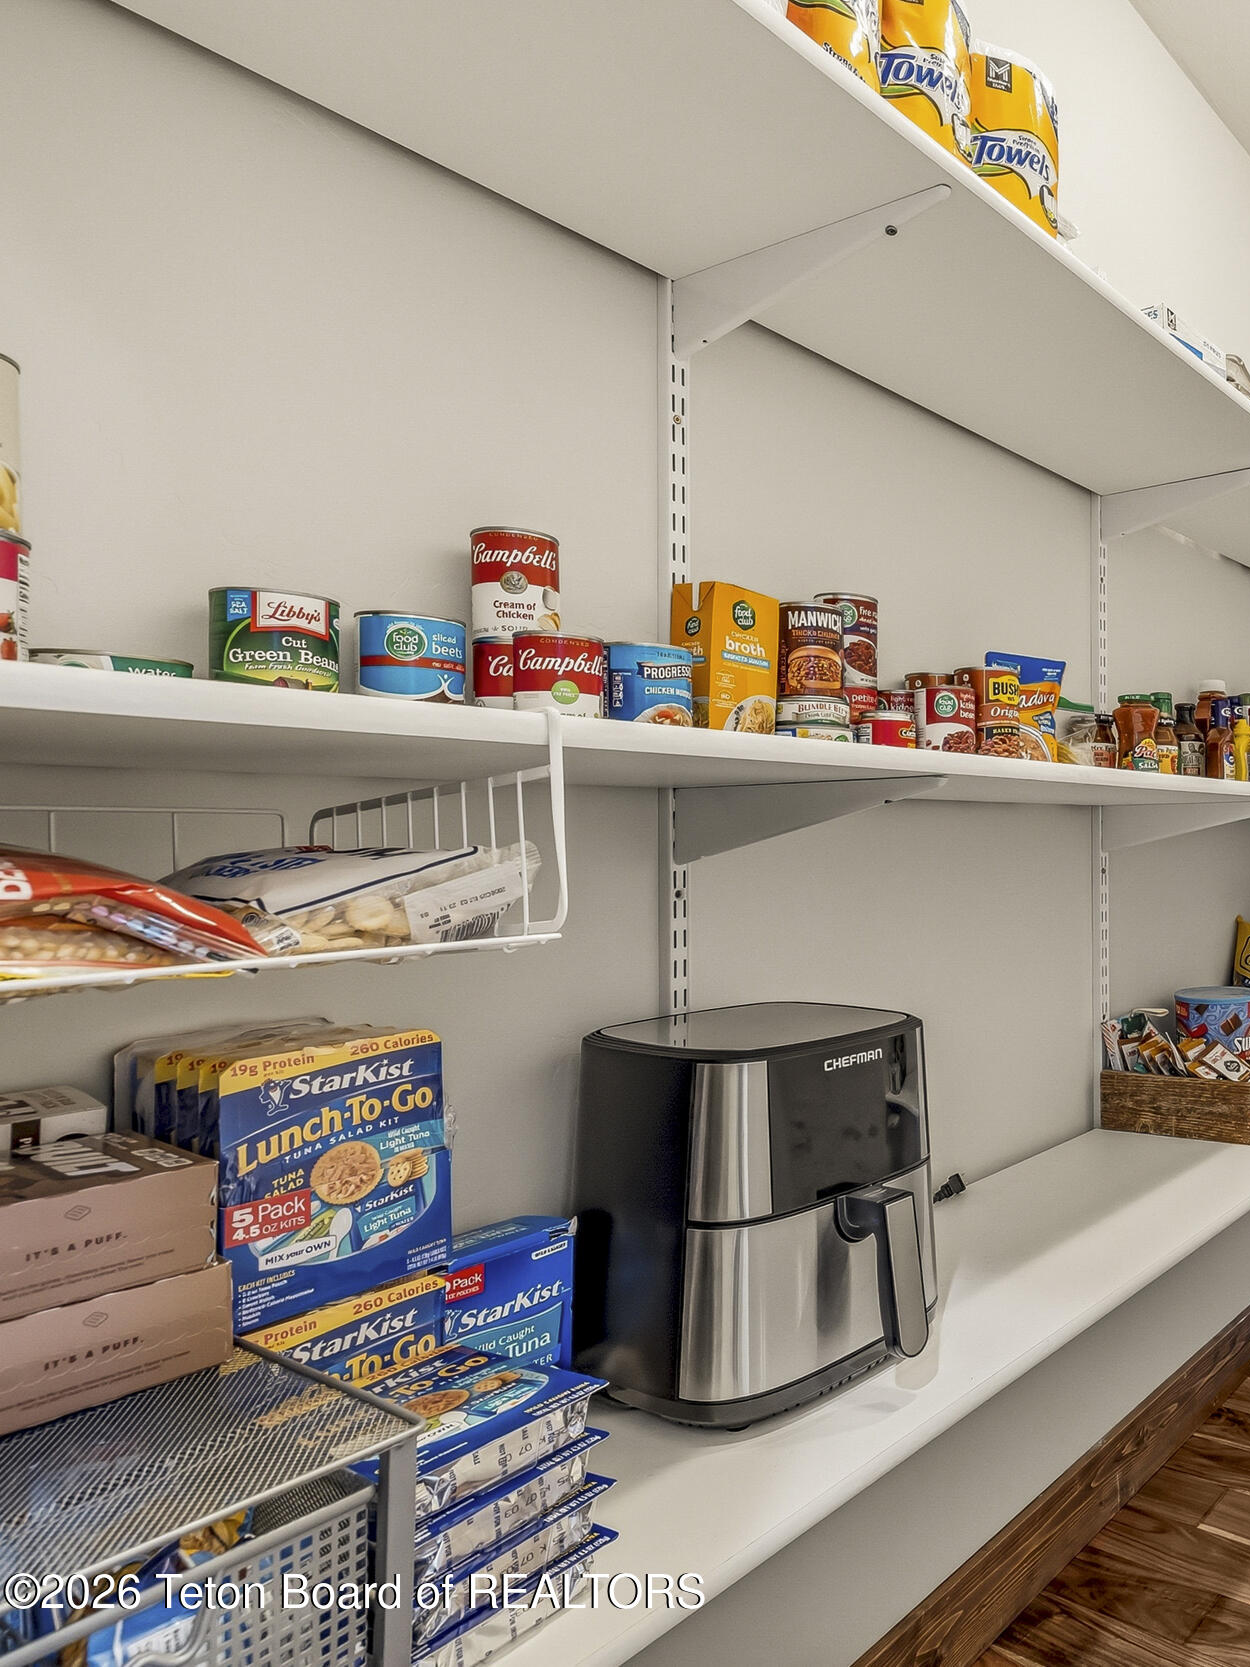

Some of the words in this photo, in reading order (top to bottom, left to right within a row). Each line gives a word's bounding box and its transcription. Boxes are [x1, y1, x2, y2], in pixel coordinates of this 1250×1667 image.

[971, 134, 1050, 183] Towels
[472, 542, 556, 571] Campbell's
[261, 600, 321, 625] Libby's
[493, 600, 525, 610] Cream
[526, 602, 536, 611] of
[496, 610, 534, 620] Chicken
[734, 606, 752, 619] food
[737, 617, 754, 626] club
[787, 610, 843, 636] MANWICH
[282, 636, 308, 648] Cut
[392, 632, 419, 643] food
[393, 642, 418, 652] club
[432, 633, 457, 644] sliced
[725, 635, 766, 657] broth
[229, 648, 293, 663] Green
[432, 643, 463, 659] beets
[518, 648, 603, 677] Campbell
[350, 1042, 379, 1055] 260
[384, 1033, 434, 1050] Calories
[167, 1053, 183, 1066] 19
[188, 1059, 205, 1072] 19
[211, 1061, 228, 1074] 19
[230, 1061, 258, 1078] 19g
[263, 1054, 315, 1072] Protein
[824, 1048, 883, 1072] CHEFMAN
[289, 1058, 415, 1099] StarKist
[236, 1083, 434, 1178] Lunch-To-Go
[284, 1142, 323, 1164] TUNA
[329, 1124, 373, 1146] SALAD
[379, 1116, 400, 1129] KIT
[380, 1136, 407, 1151] Light
[408, 1130, 430, 1143] Tuna
[264, 1178, 305, 1200] SALAD
[272, 1168, 305, 1187] TUNA
[364, 1183, 415, 1211] StarKist
[231, 1209, 254, 1228] 5
[258, 1196, 306, 1223] Pack
[363, 1218, 388, 1233] Light
[388, 1207, 412, 1222] Tuna
[232, 1223, 262, 1241] 4.5
[262, 1222, 279, 1235] OZ
[280, 1216, 306, 1231] KITS
[25, 1247, 59, 1262] IT'S
[67, 1243, 77, 1252] A
[84, 1231, 129, 1248] PUFF.
[264, 1253, 284, 1266] MIX
[284, 1247, 304, 1263] your
[305, 1238, 331, 1253] OWN
[452, 1272, 483, 1291] Pack
[352, 1298, 384, 1316] 260
[385, 1279, 439, 1301] Calories
[458, 1280, 563, 1333] StarKist
[263, 1319, 317, 1345] Protein
[290, 1307, 419, 1365] StarKist
[498, 1325, 535, 1345] Caught
[43, 1354, 77, 1372] IT'S
[85, 1349, 94, 1359] A
[101, 1335, 145, 1354] PUFF.
[505, 1331, 551, 1358] Tuna
[322, 1333, 436, 1381] -To-Go
[533, 1353, 553, 1366] TER
[371, 1357, 448, 1394] rKist
